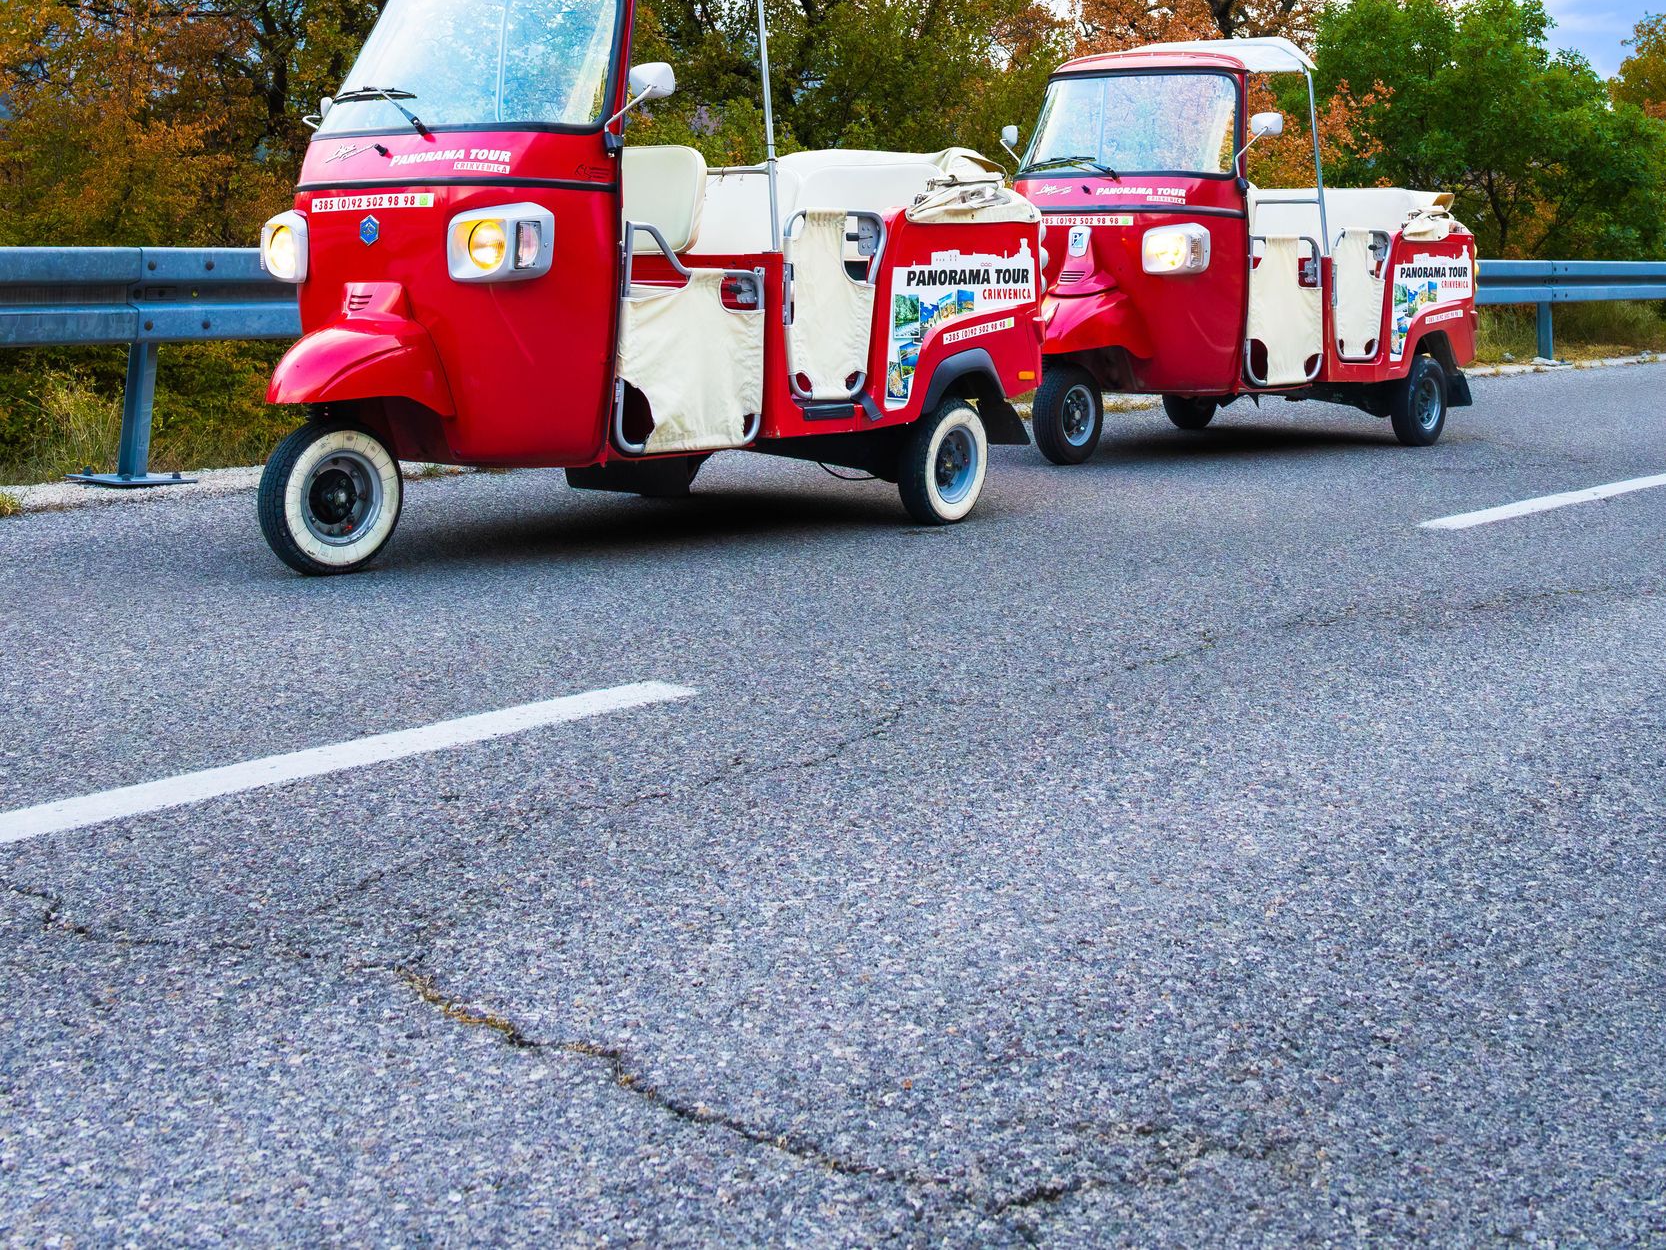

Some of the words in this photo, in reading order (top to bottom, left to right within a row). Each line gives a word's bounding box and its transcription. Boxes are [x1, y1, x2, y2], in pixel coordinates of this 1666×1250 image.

[389, 149, 464, 167] PANORAMA
[469, 148, 512, 163] TOUR
[455, 161, 507, 173] CRIKVENICA
[1096, 187, 1153, 196] PANORAMA
[1157, 187, 1186, 197] TOUR
[314, 200, 334, 210] +385
[337, 197, 363, 209] (0)92
[366, 196, 384, 207] 502
[387, 195, 399, 206] 98
[403, 195, 416, 206] 98
[1056, 217, 1077, 225] (0)92
[1080, 217, 1093, 225] 502
[1096, 217, 1106, 225] 98
[1109, 217, 1119, 225] 98
[906, 269, 991, 287] PANORAMA
[995, 268, 1030, 285] TOUR
[1400, 266, 1446, 278] PANORAMA
[1449, 266, 1468, 278] TOUR
[1441, 280, 1469, 289] CRIKVENICA
[982, 288, 1032, 300] CRIKVENICA
